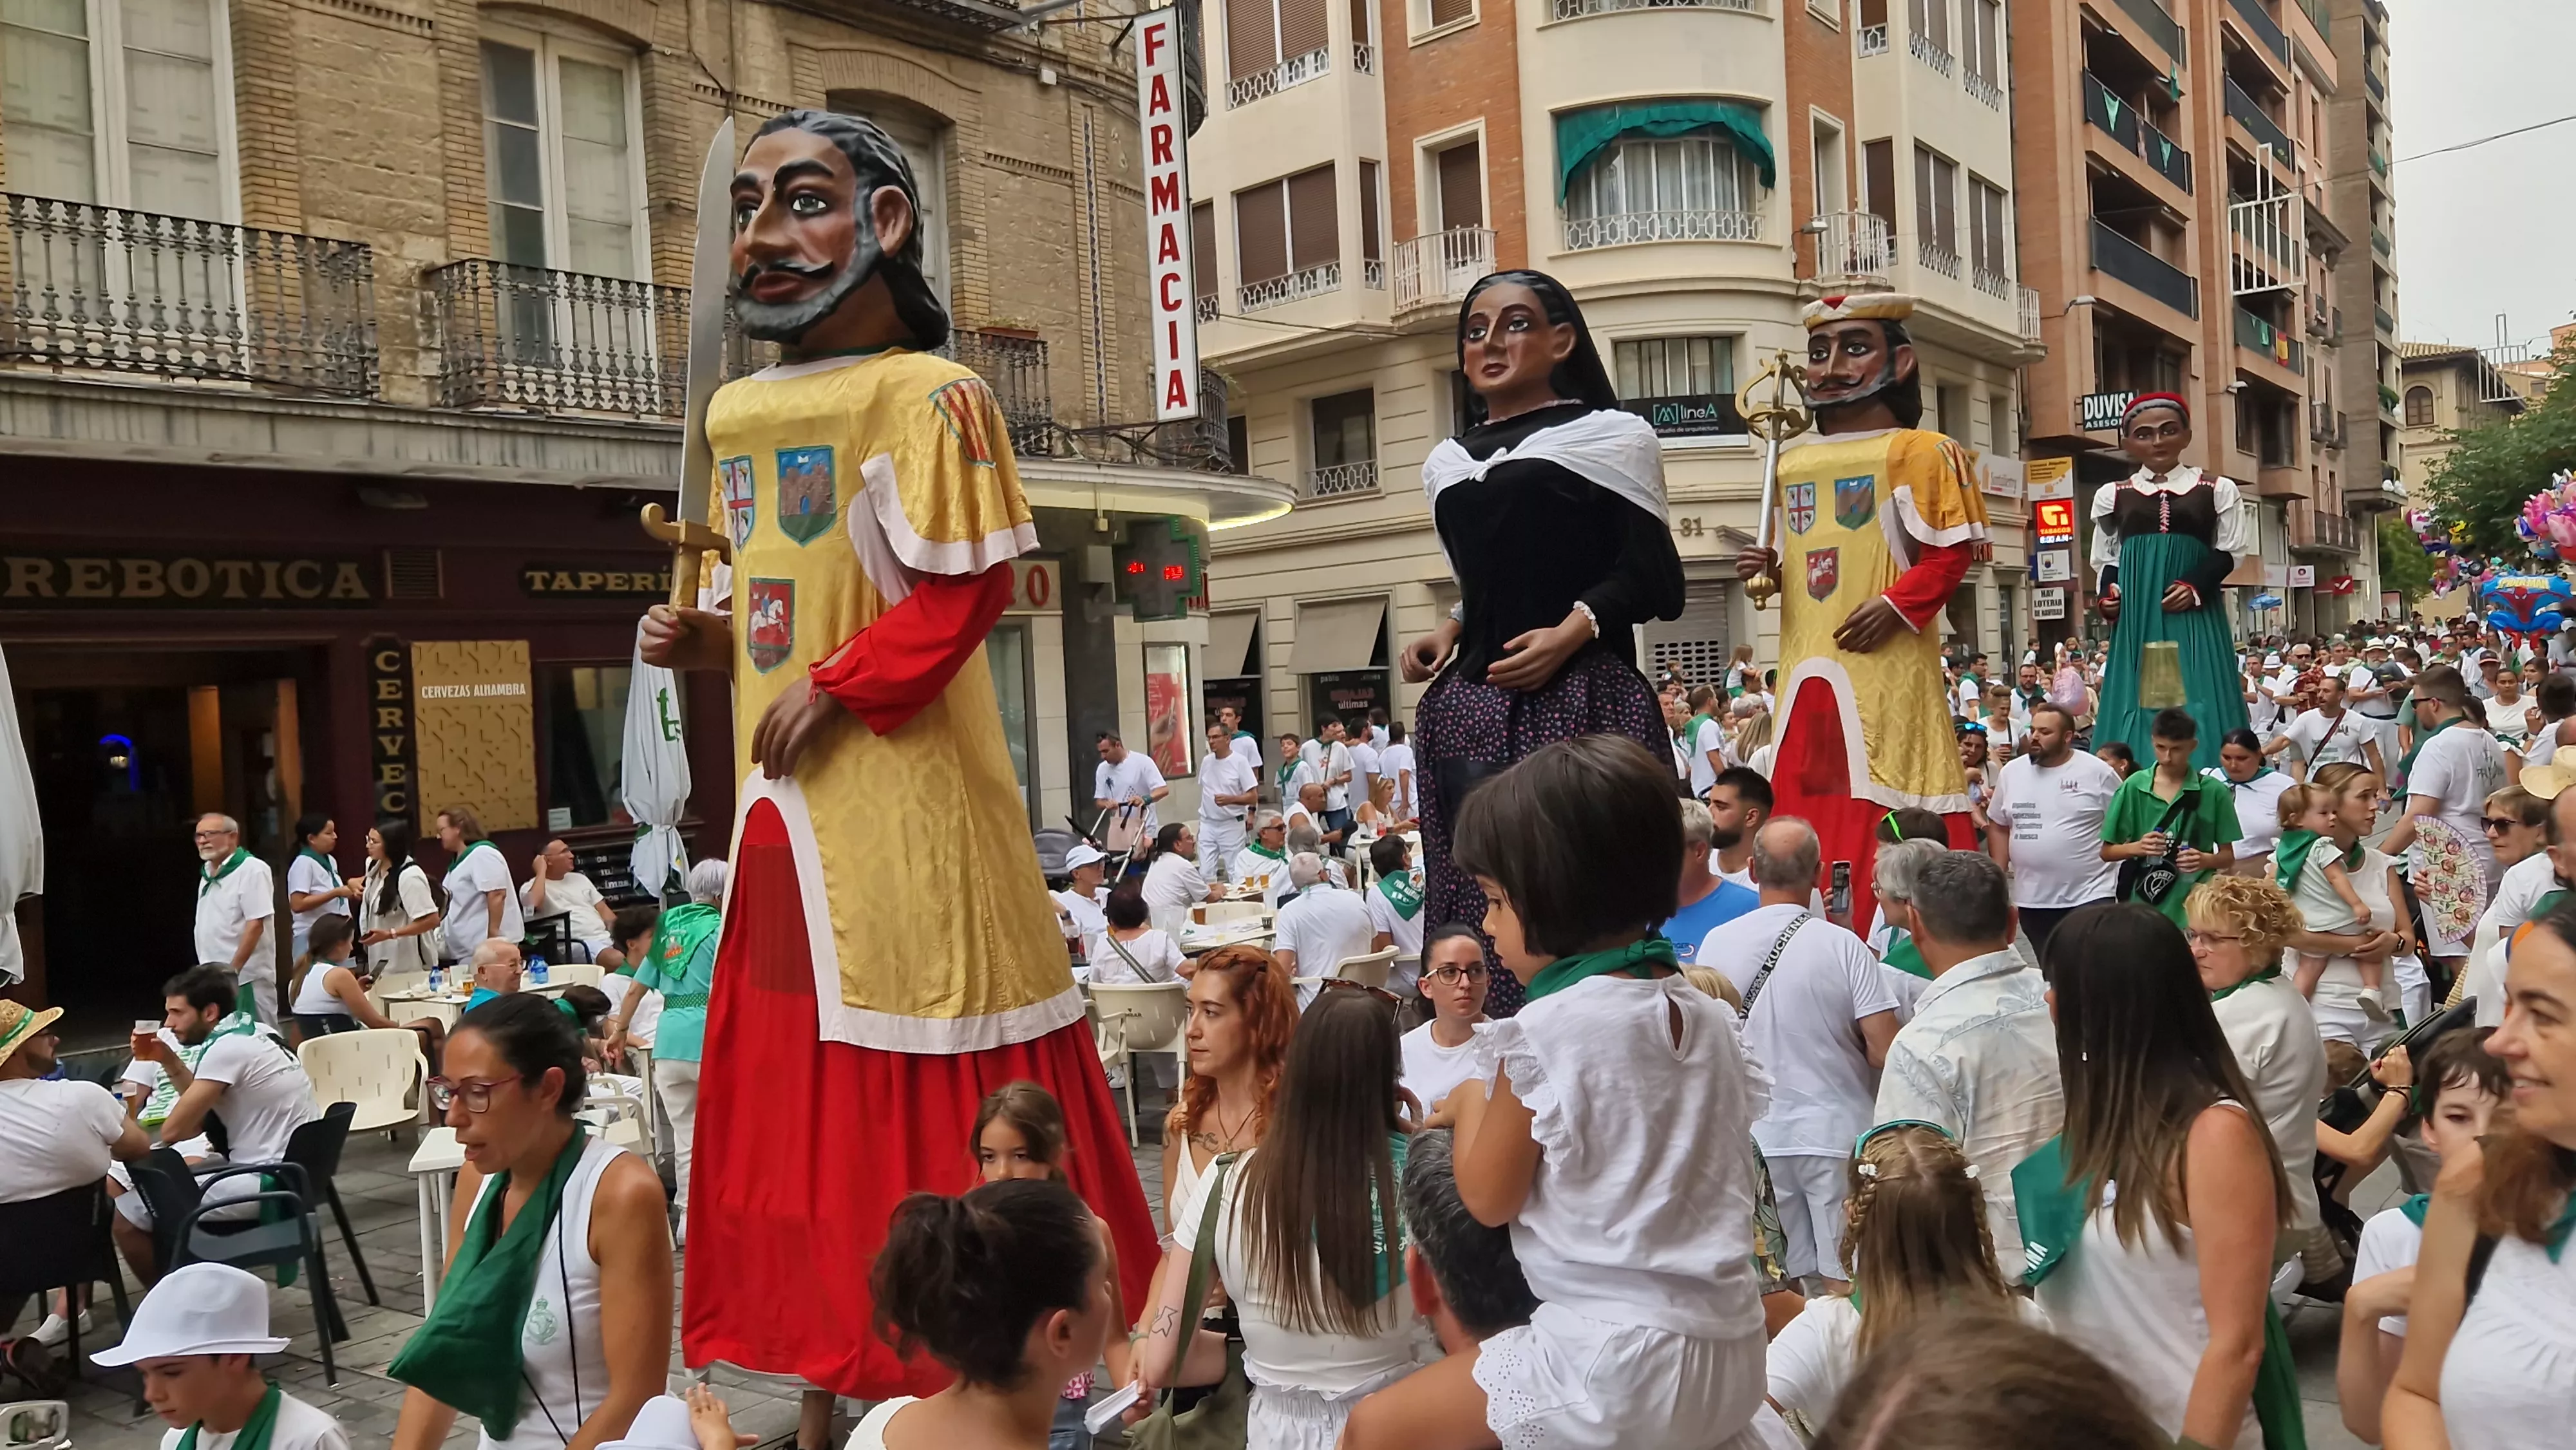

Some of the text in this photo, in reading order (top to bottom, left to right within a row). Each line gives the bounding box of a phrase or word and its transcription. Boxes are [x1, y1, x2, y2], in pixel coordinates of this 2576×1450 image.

[1143, 22, 1188, 411] FARMACIA
[1680, 516, 1705, 538] 31
[2040, 527, 2072, 535] TABACOS
[3, 556, 370, 599] REBOTICA
[526, 565, 672, 591] TAPERÍ
[2041, 589, 2054, 598] HAY
[2034, 599, 2063, 608] LOTERIA
[421, 682, 527, 699] CERVEZAS ALHAMBRA
[1338, 700, 1368, 710] últimas
[374, 651, 406, 813] CERVEC
